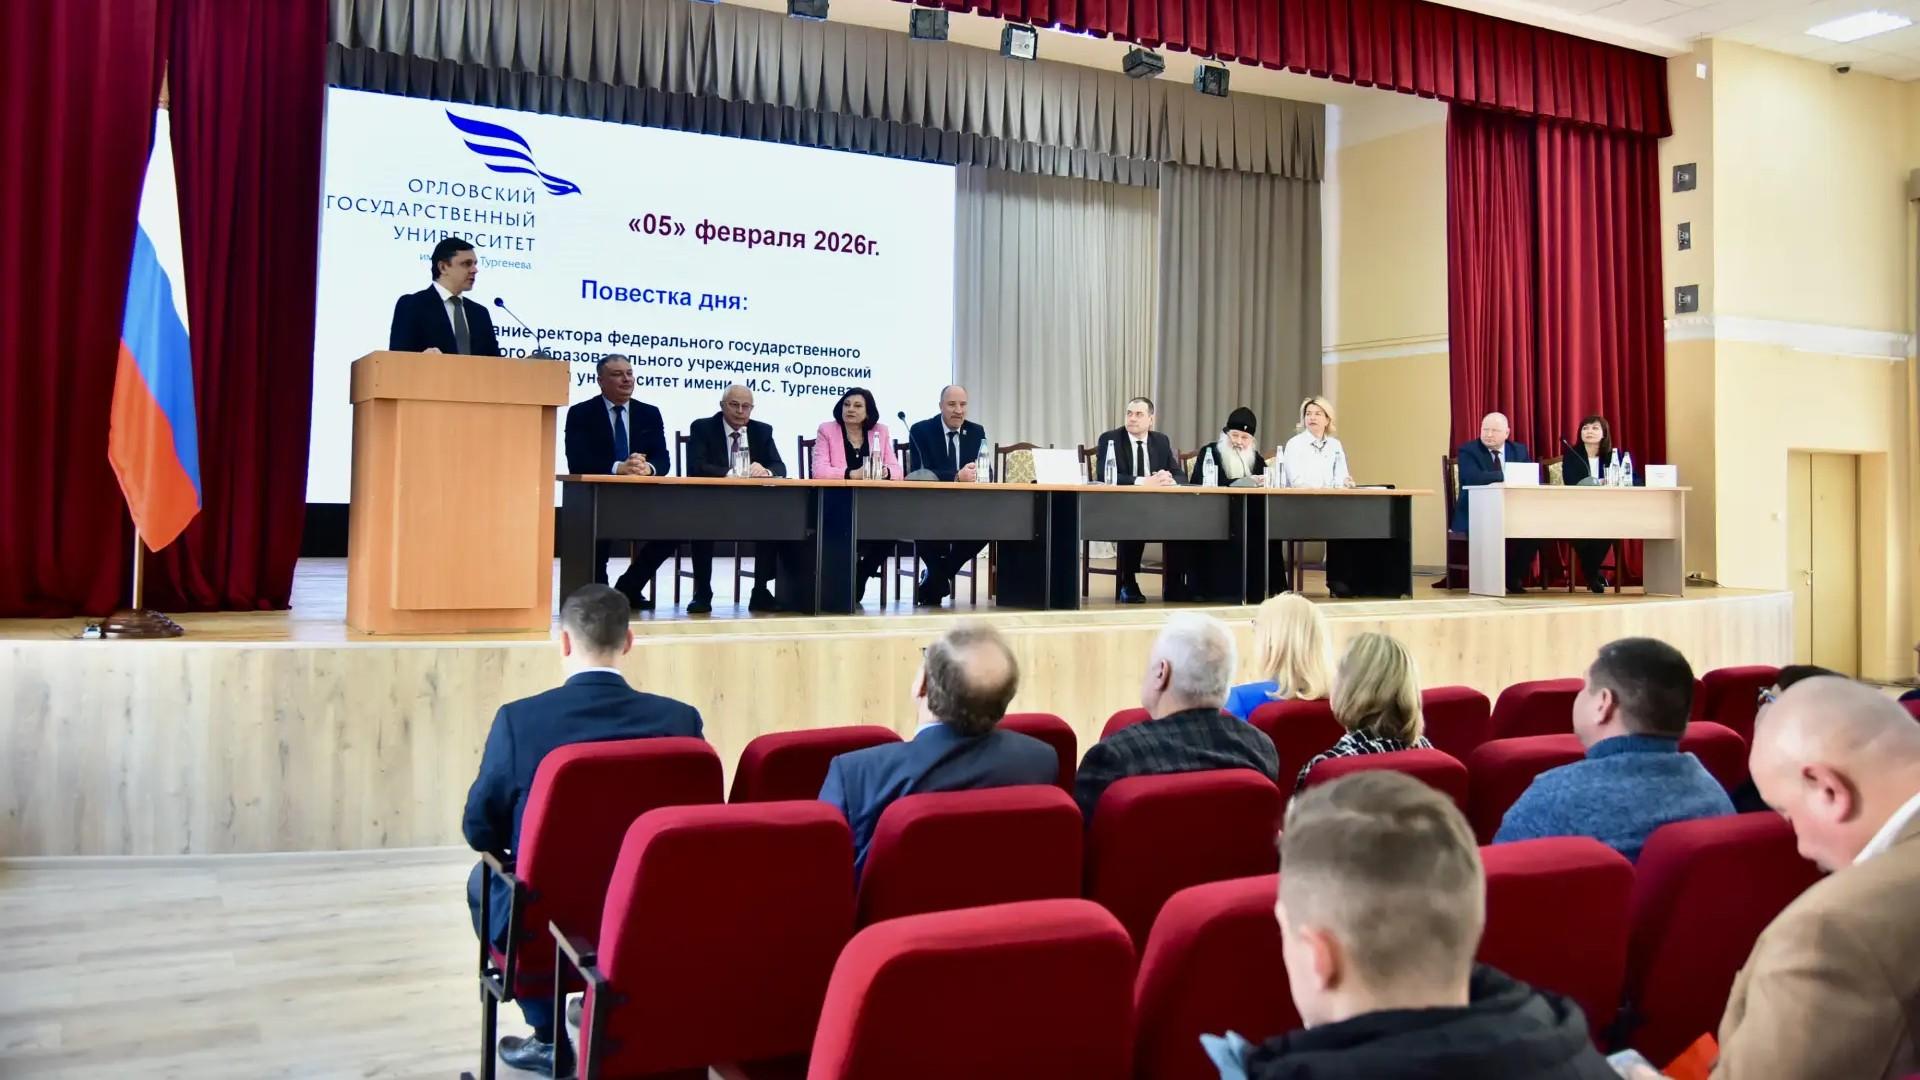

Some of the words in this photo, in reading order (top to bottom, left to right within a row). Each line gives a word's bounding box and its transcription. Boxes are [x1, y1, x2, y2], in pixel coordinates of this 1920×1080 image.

[408, 178, 536, 205] ОРЛОВСКИЙ
[326, 195, 536, 228] ГОСУДАРСТВЕННЫЙ
[628, 213, 686, 237] «05»
[695, 219, 806, 249] февраля
[814, 230, 880, 256] 2026г.
[480, 256, 532, 271] Тургенева
[581, 280, 692, 307] Повестка
[699, 291, 749, 311] дня:
[537, 328, 602, 345] ректора
[608, 331, 724, 352] федерального
[729, 340, 861, 359] государственного
[688, 357, 780, 374] учреждения
[785, 361, 872, 379] «Орловский
[746, 378, 776, 394] И.С.
